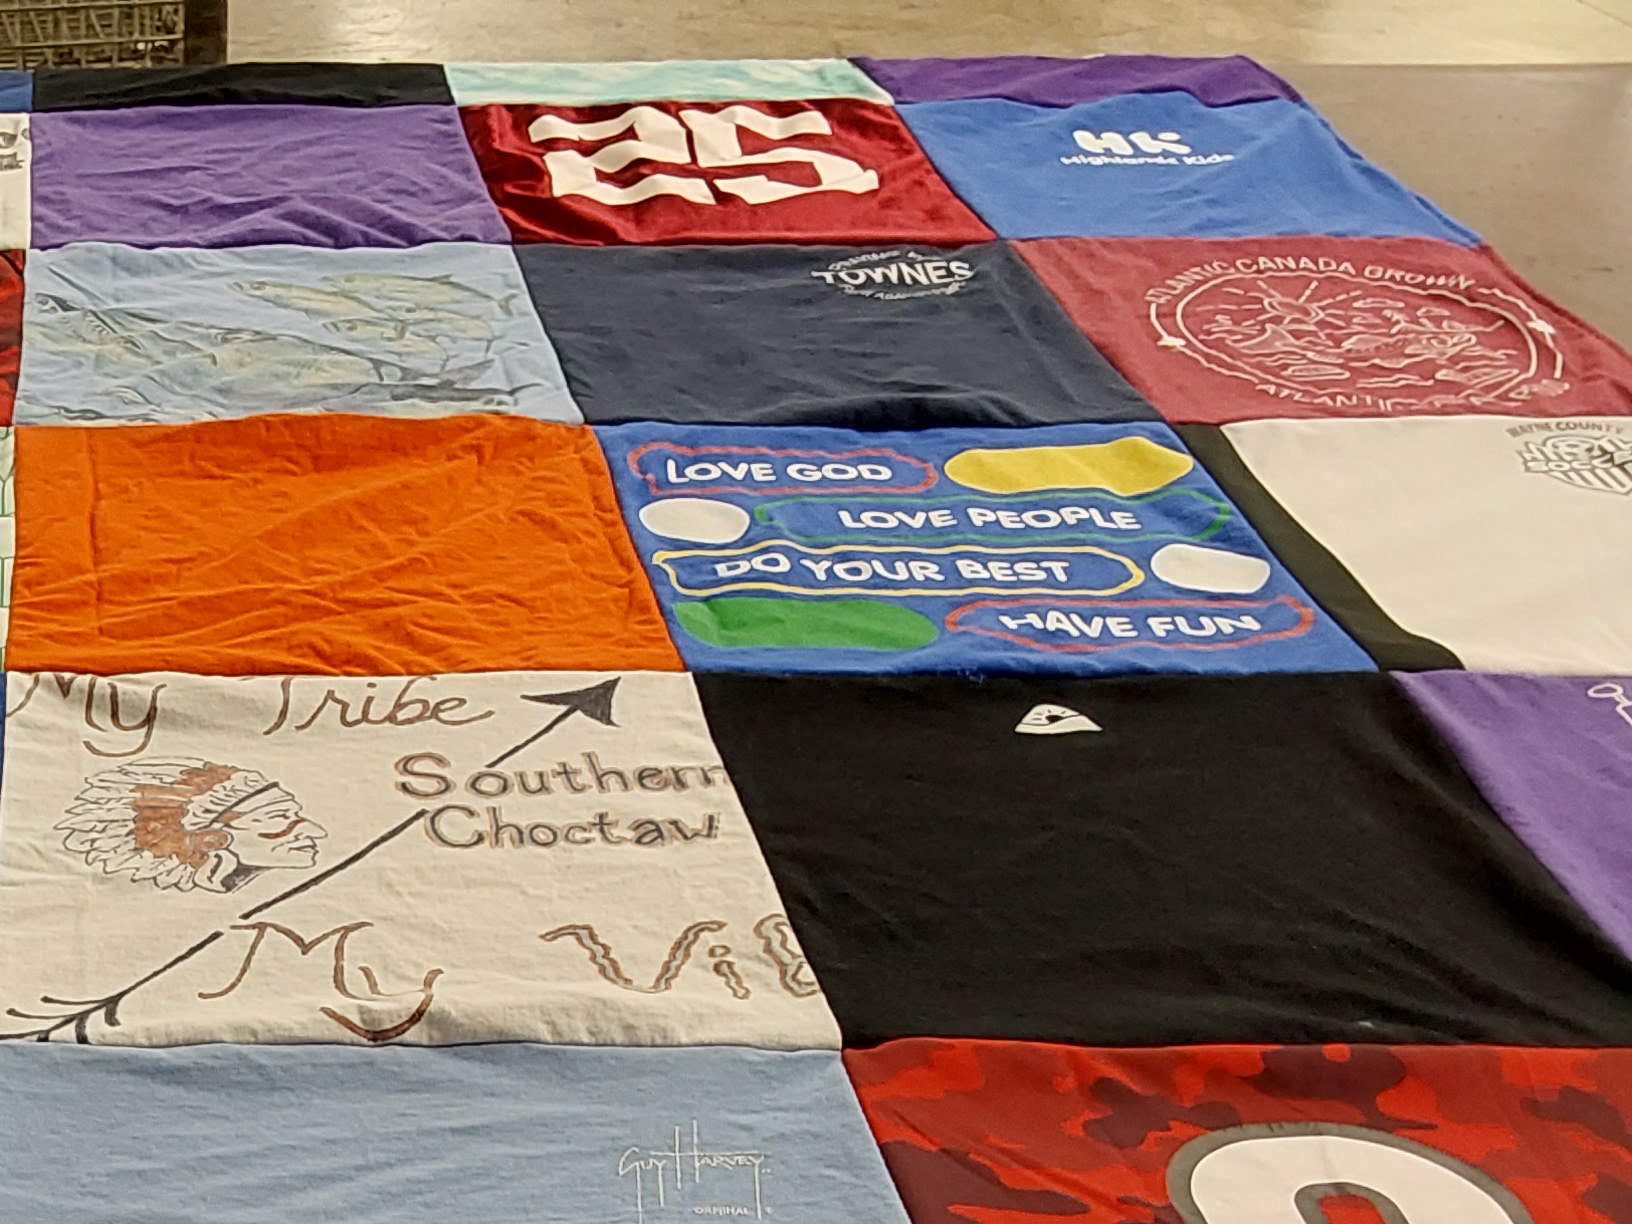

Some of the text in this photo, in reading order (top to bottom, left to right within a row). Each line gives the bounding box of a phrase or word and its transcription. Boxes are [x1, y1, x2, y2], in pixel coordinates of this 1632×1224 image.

[527, 105, 879, 206] 25
[1072, 129, 1192, 156] HK
[810, 260, 975, 286] TOWNES
[1145, 256, 1476, 304] ATLANTIC CANADA GROWN
[1555, 421, 1625, 435] COUNTY
[666, 457, 894, 485] LOVE GOD
[837, 504, 1144, 531] LOVE PEOPLE
[714, 551, 1070, 583] DO YOUR BEST
[999, 609, 1262, 639] HAVE FUN
[422, 804, 721, 851] Choctaw
[196, 919, 443, 1043] My
